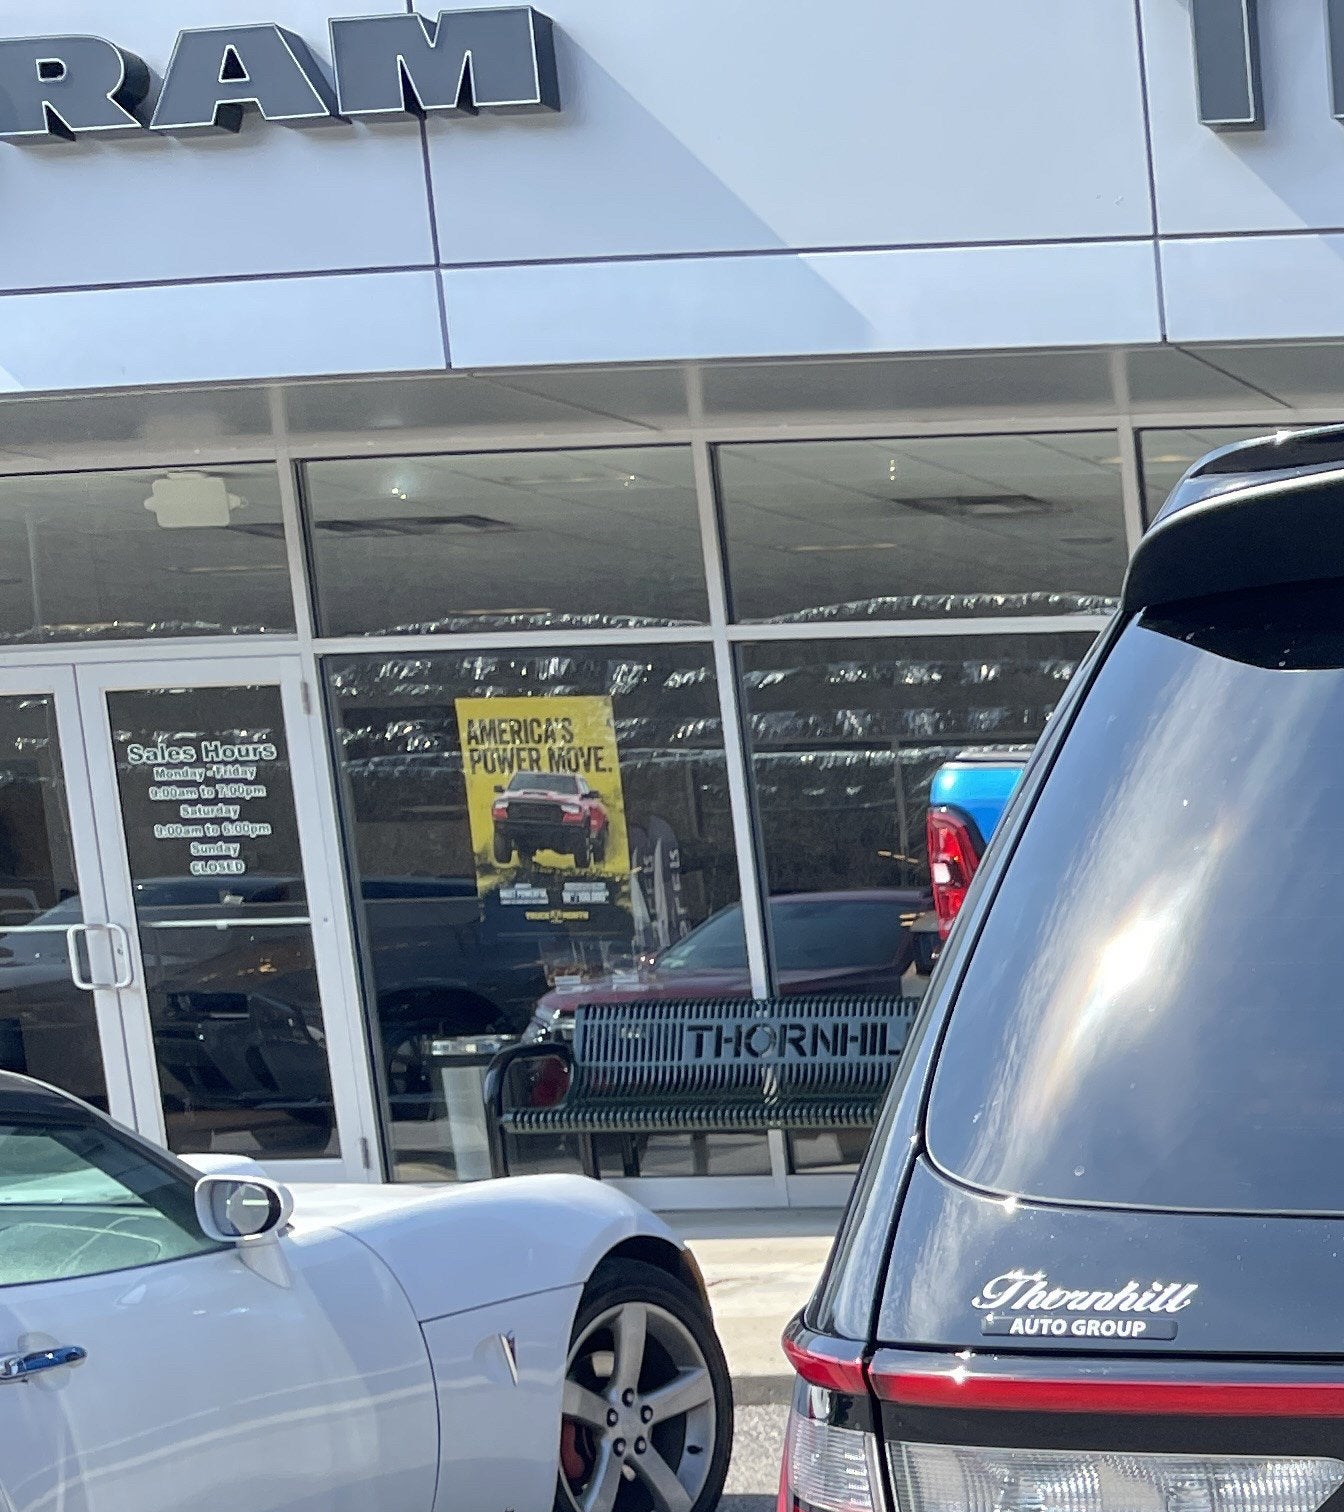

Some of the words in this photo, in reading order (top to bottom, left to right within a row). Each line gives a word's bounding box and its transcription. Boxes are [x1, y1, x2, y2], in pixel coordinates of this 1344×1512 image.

[0, 5, 557, 140] RAM
[467, 717, 574, 745] AMERICA'S
[127, 743, 197, 764] Sales
[201, 741, 277, 761] Hours
[470, 747, 541, 774] POWER
[547, 746, 613, 773] MOVE.
[153, 766, 205, 781] Monday
[214, 764, 257, 781] Friday
[149, 786, 198, 802] 9:00am
[200, 785, 216, 799] to
[180, 803, 240, 820] Saturday
[204, 822, 221, 837] to
[190, 841, 241, 858] Sunday
[190, 860, 246, 875] CLOSED
[971, 1268, 1199, 1312] Thornhill
[1010, 1318, 1068, 1335] AUTO
[1071, 1319, 1147, 1337] GROUP
